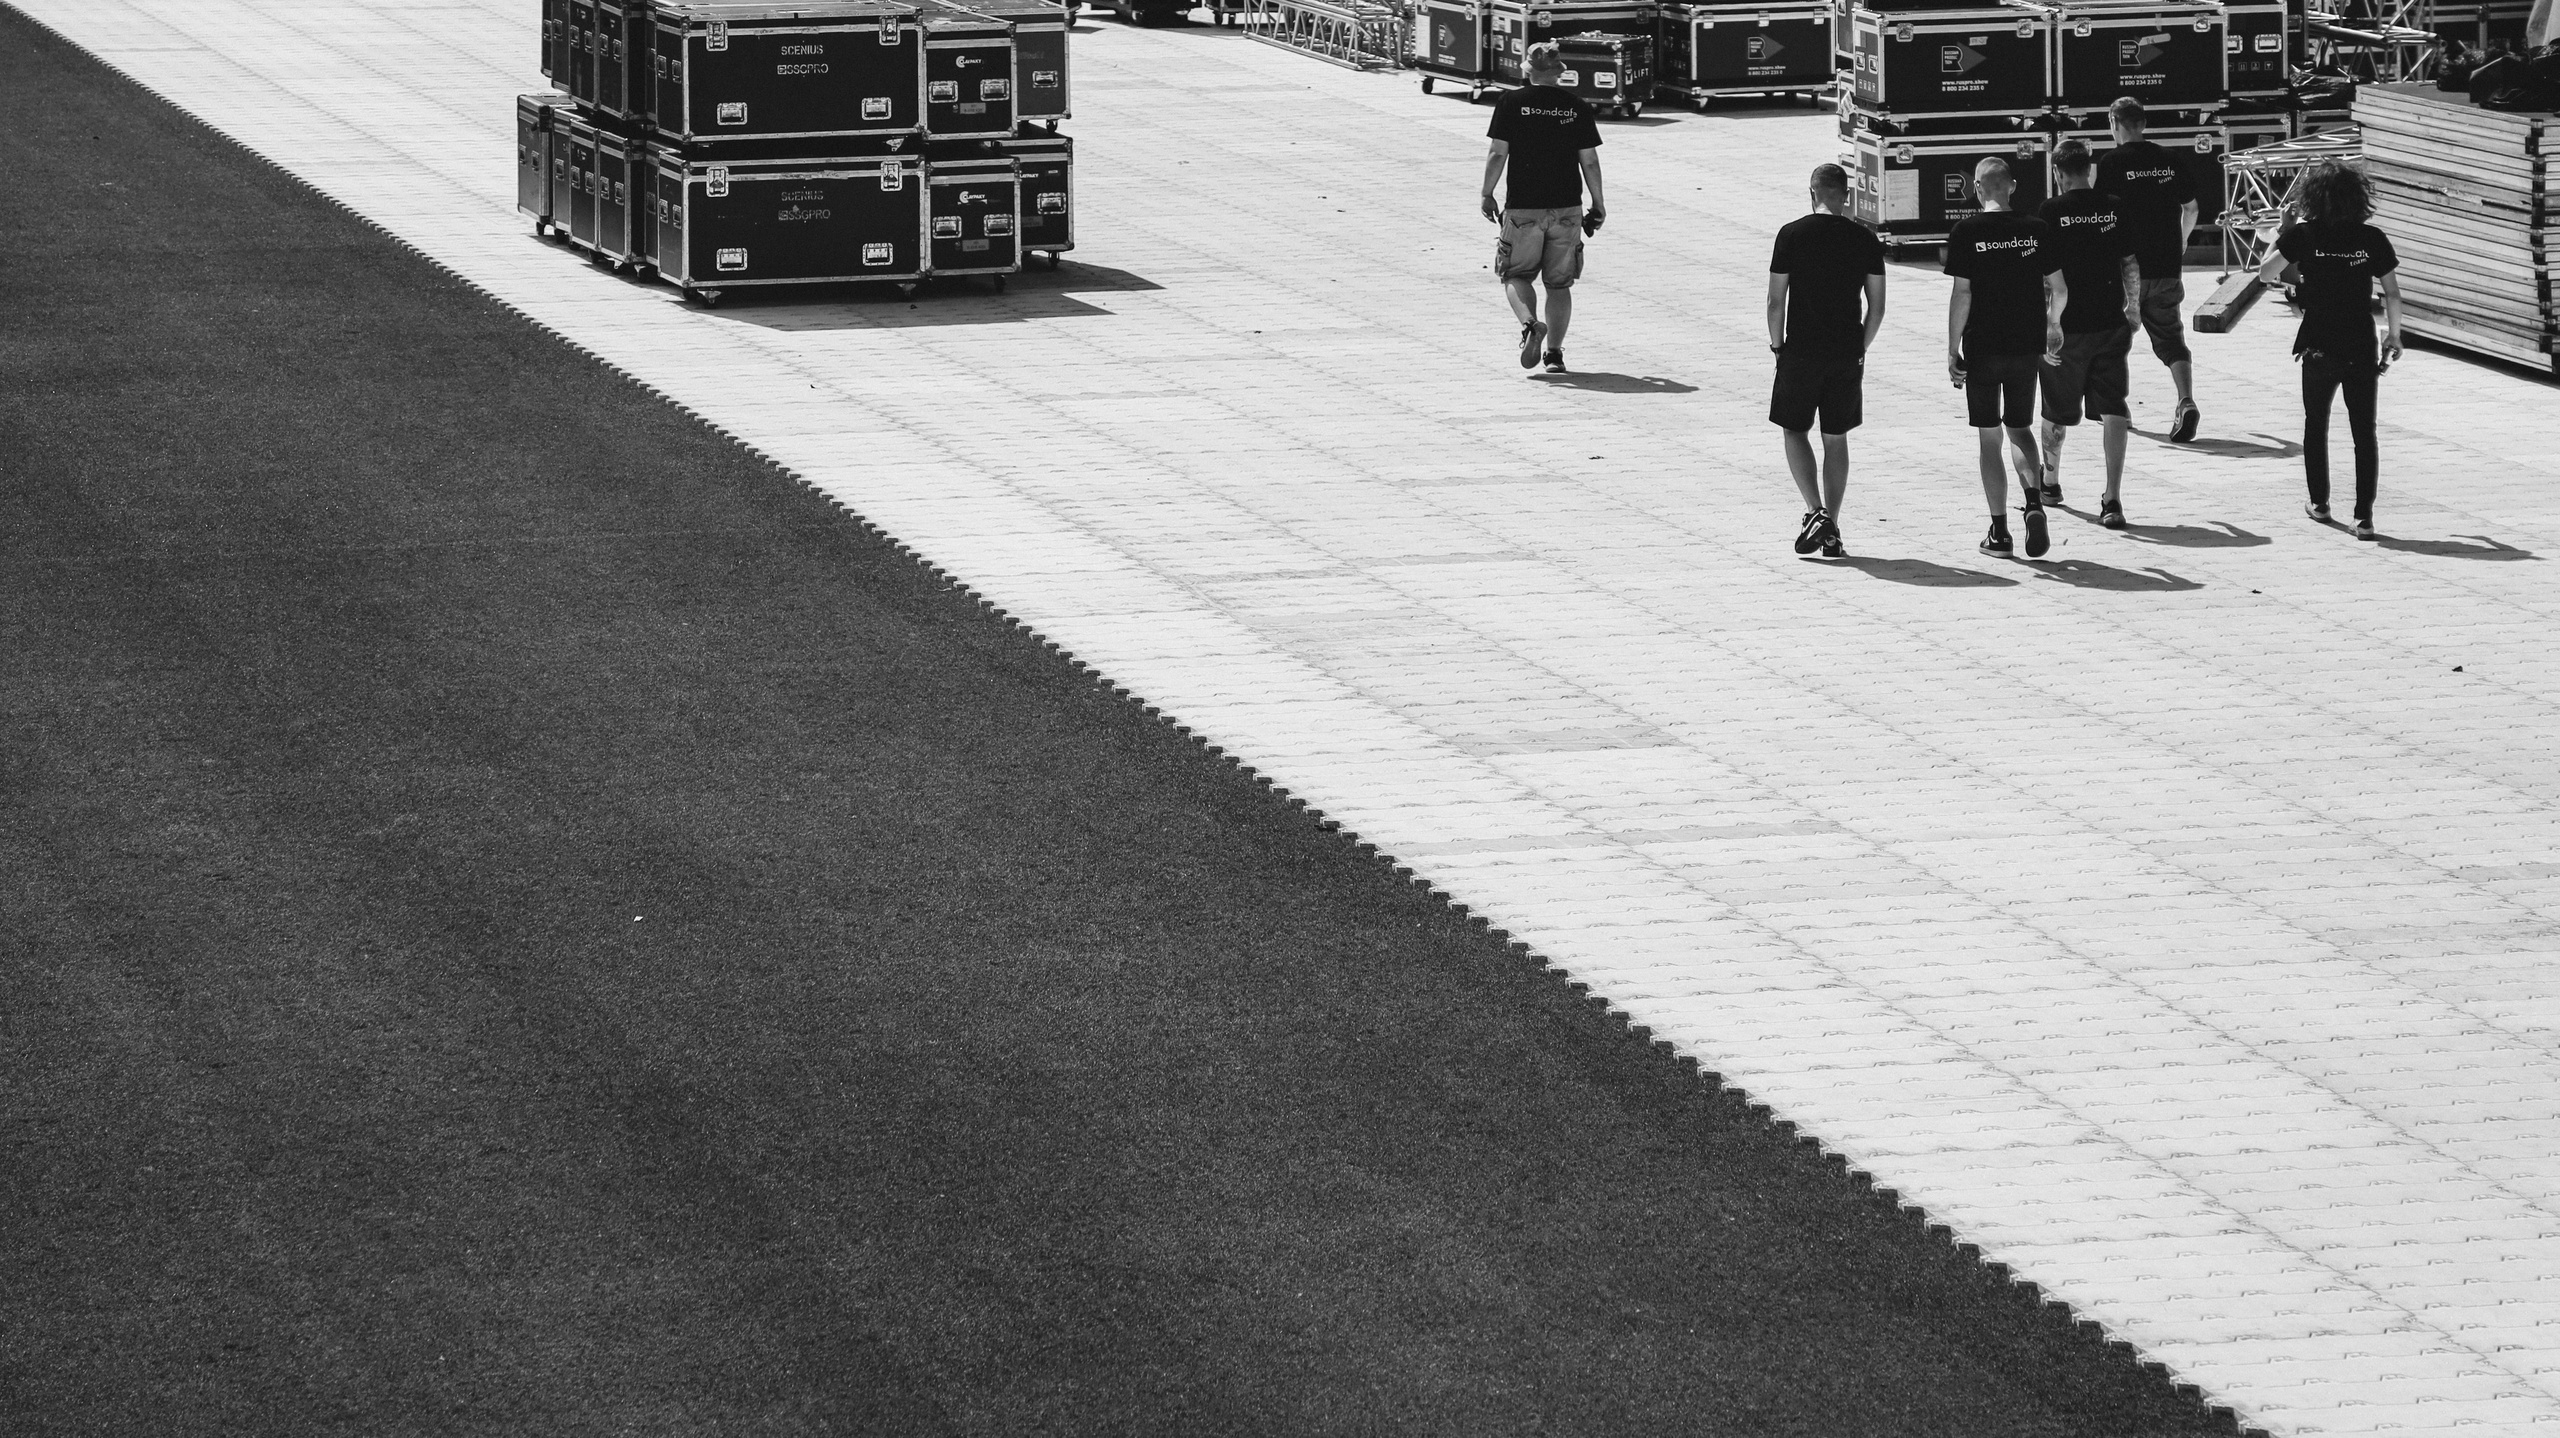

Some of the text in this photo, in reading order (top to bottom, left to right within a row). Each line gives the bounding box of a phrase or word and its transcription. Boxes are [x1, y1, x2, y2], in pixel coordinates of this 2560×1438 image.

[781, 45, 824, 55] SCENIUS
[1634, 68, 1649, 79] LIFT
[2135, 165, 2176, 178] soundcafe
[781, 190, 824, 201] SCENIUS
[1986, 235, 2039, 250] soundcafe
[2021, 247, 2036, 258] team
